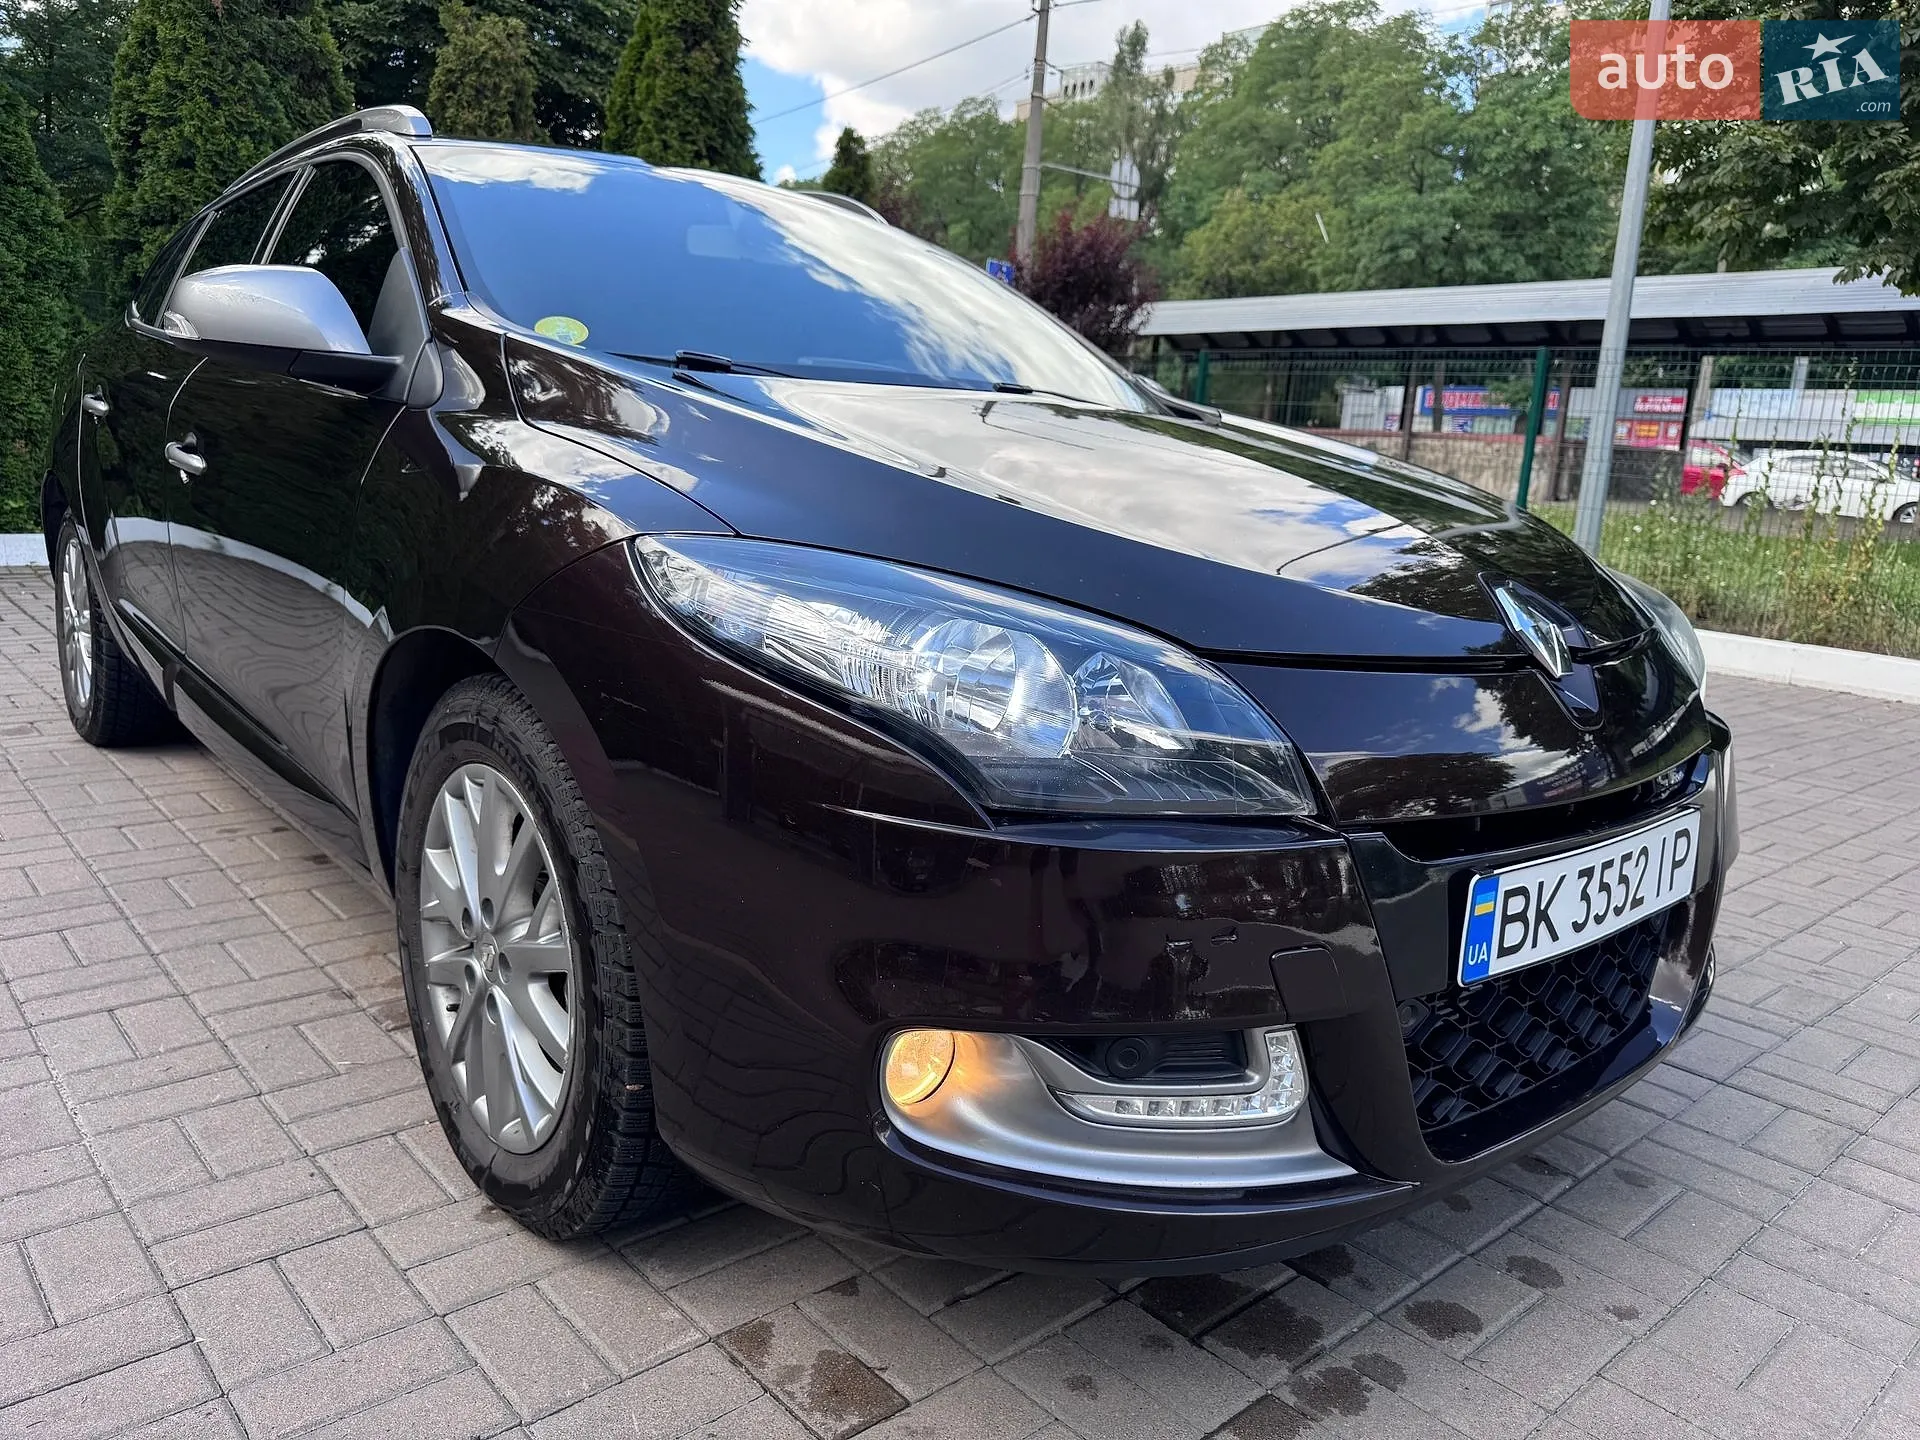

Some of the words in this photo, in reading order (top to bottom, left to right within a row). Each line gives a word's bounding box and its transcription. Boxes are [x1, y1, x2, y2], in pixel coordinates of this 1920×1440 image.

[1496, 873, 1566, 959] BK
[1571, 845, 1649, 934] 3552
[1655, 828, 1691, 898] IP
[1468, 942, 1488, 965] UA
